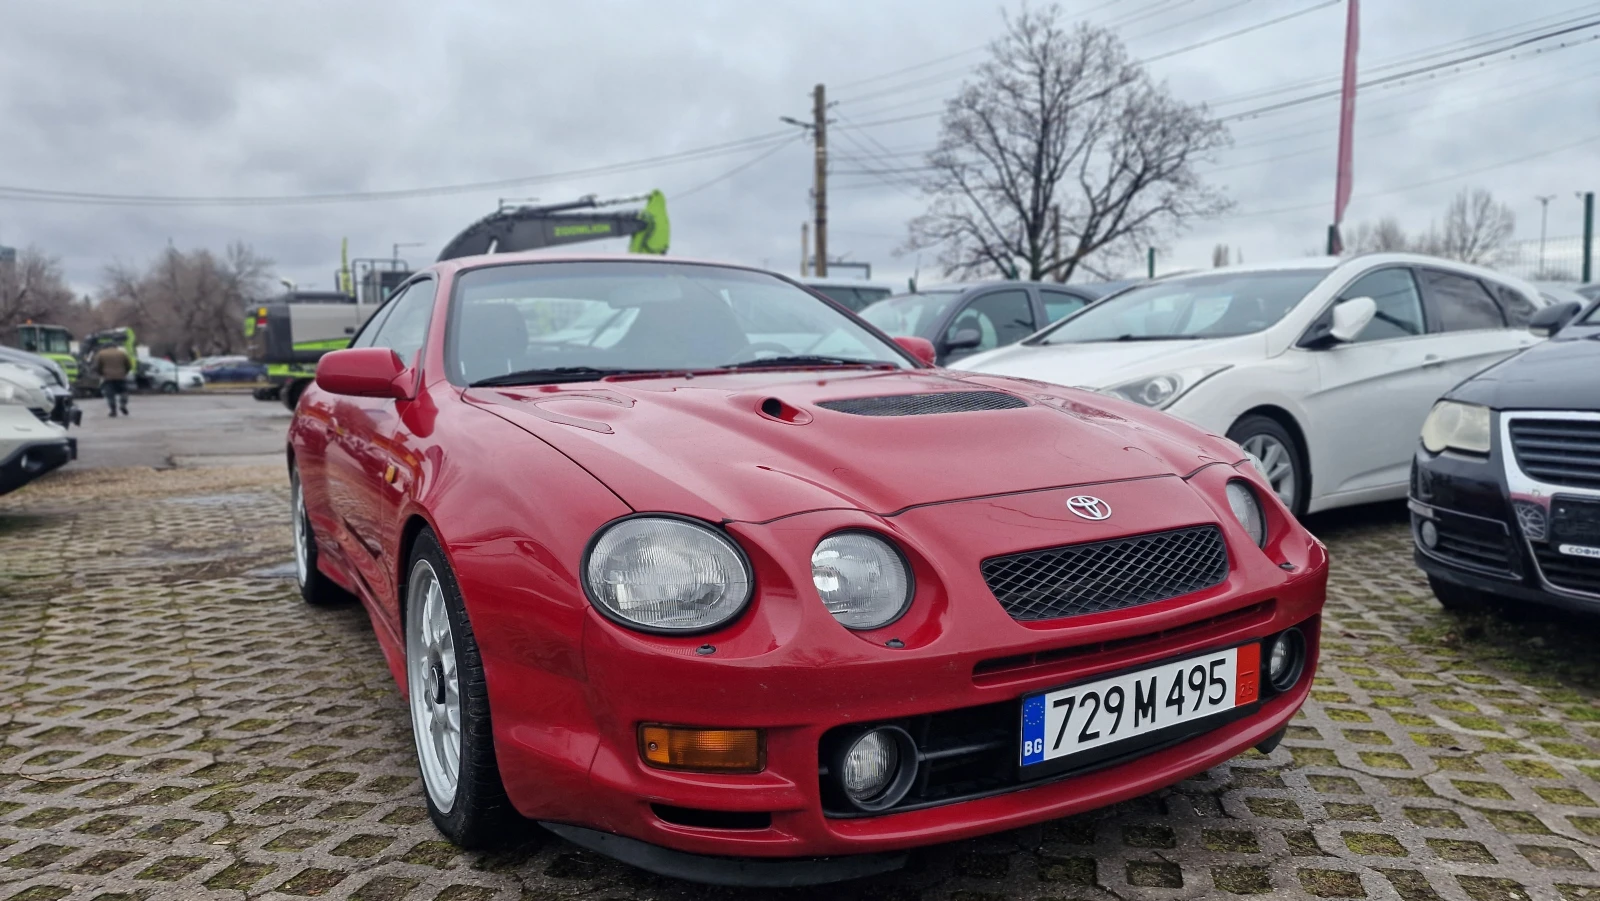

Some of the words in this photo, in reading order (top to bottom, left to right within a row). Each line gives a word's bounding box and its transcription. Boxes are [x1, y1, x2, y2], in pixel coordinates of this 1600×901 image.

[1052, 685, 1125, 751] 729
[1134, 676, 1157, 728] M
[1165, 658, 1227, 716] 495
[1024, 738, 1042, 757] BG
